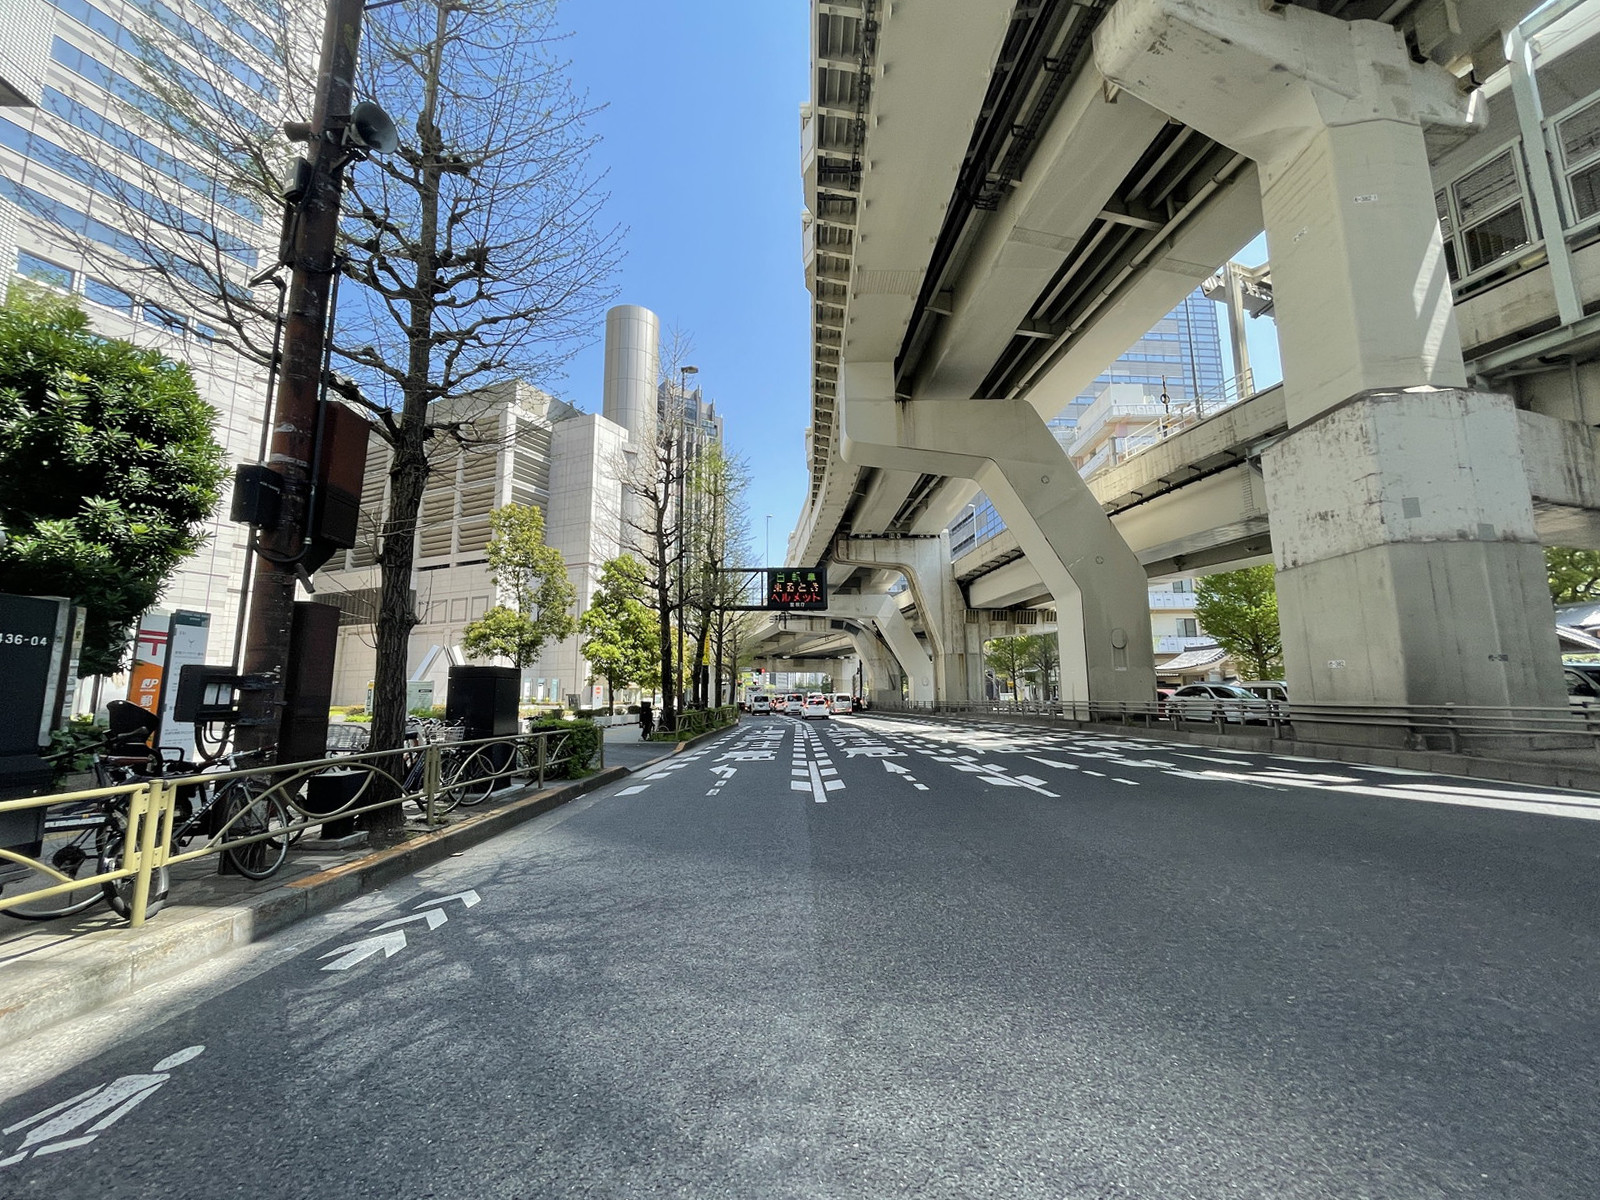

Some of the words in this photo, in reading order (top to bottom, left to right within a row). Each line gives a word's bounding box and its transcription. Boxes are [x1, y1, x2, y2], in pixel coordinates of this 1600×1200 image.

[776, 571, 816, 583] 自転車
[771, 593, 821, 603] ヘルメット
[141, 678, 159, 688] JP
